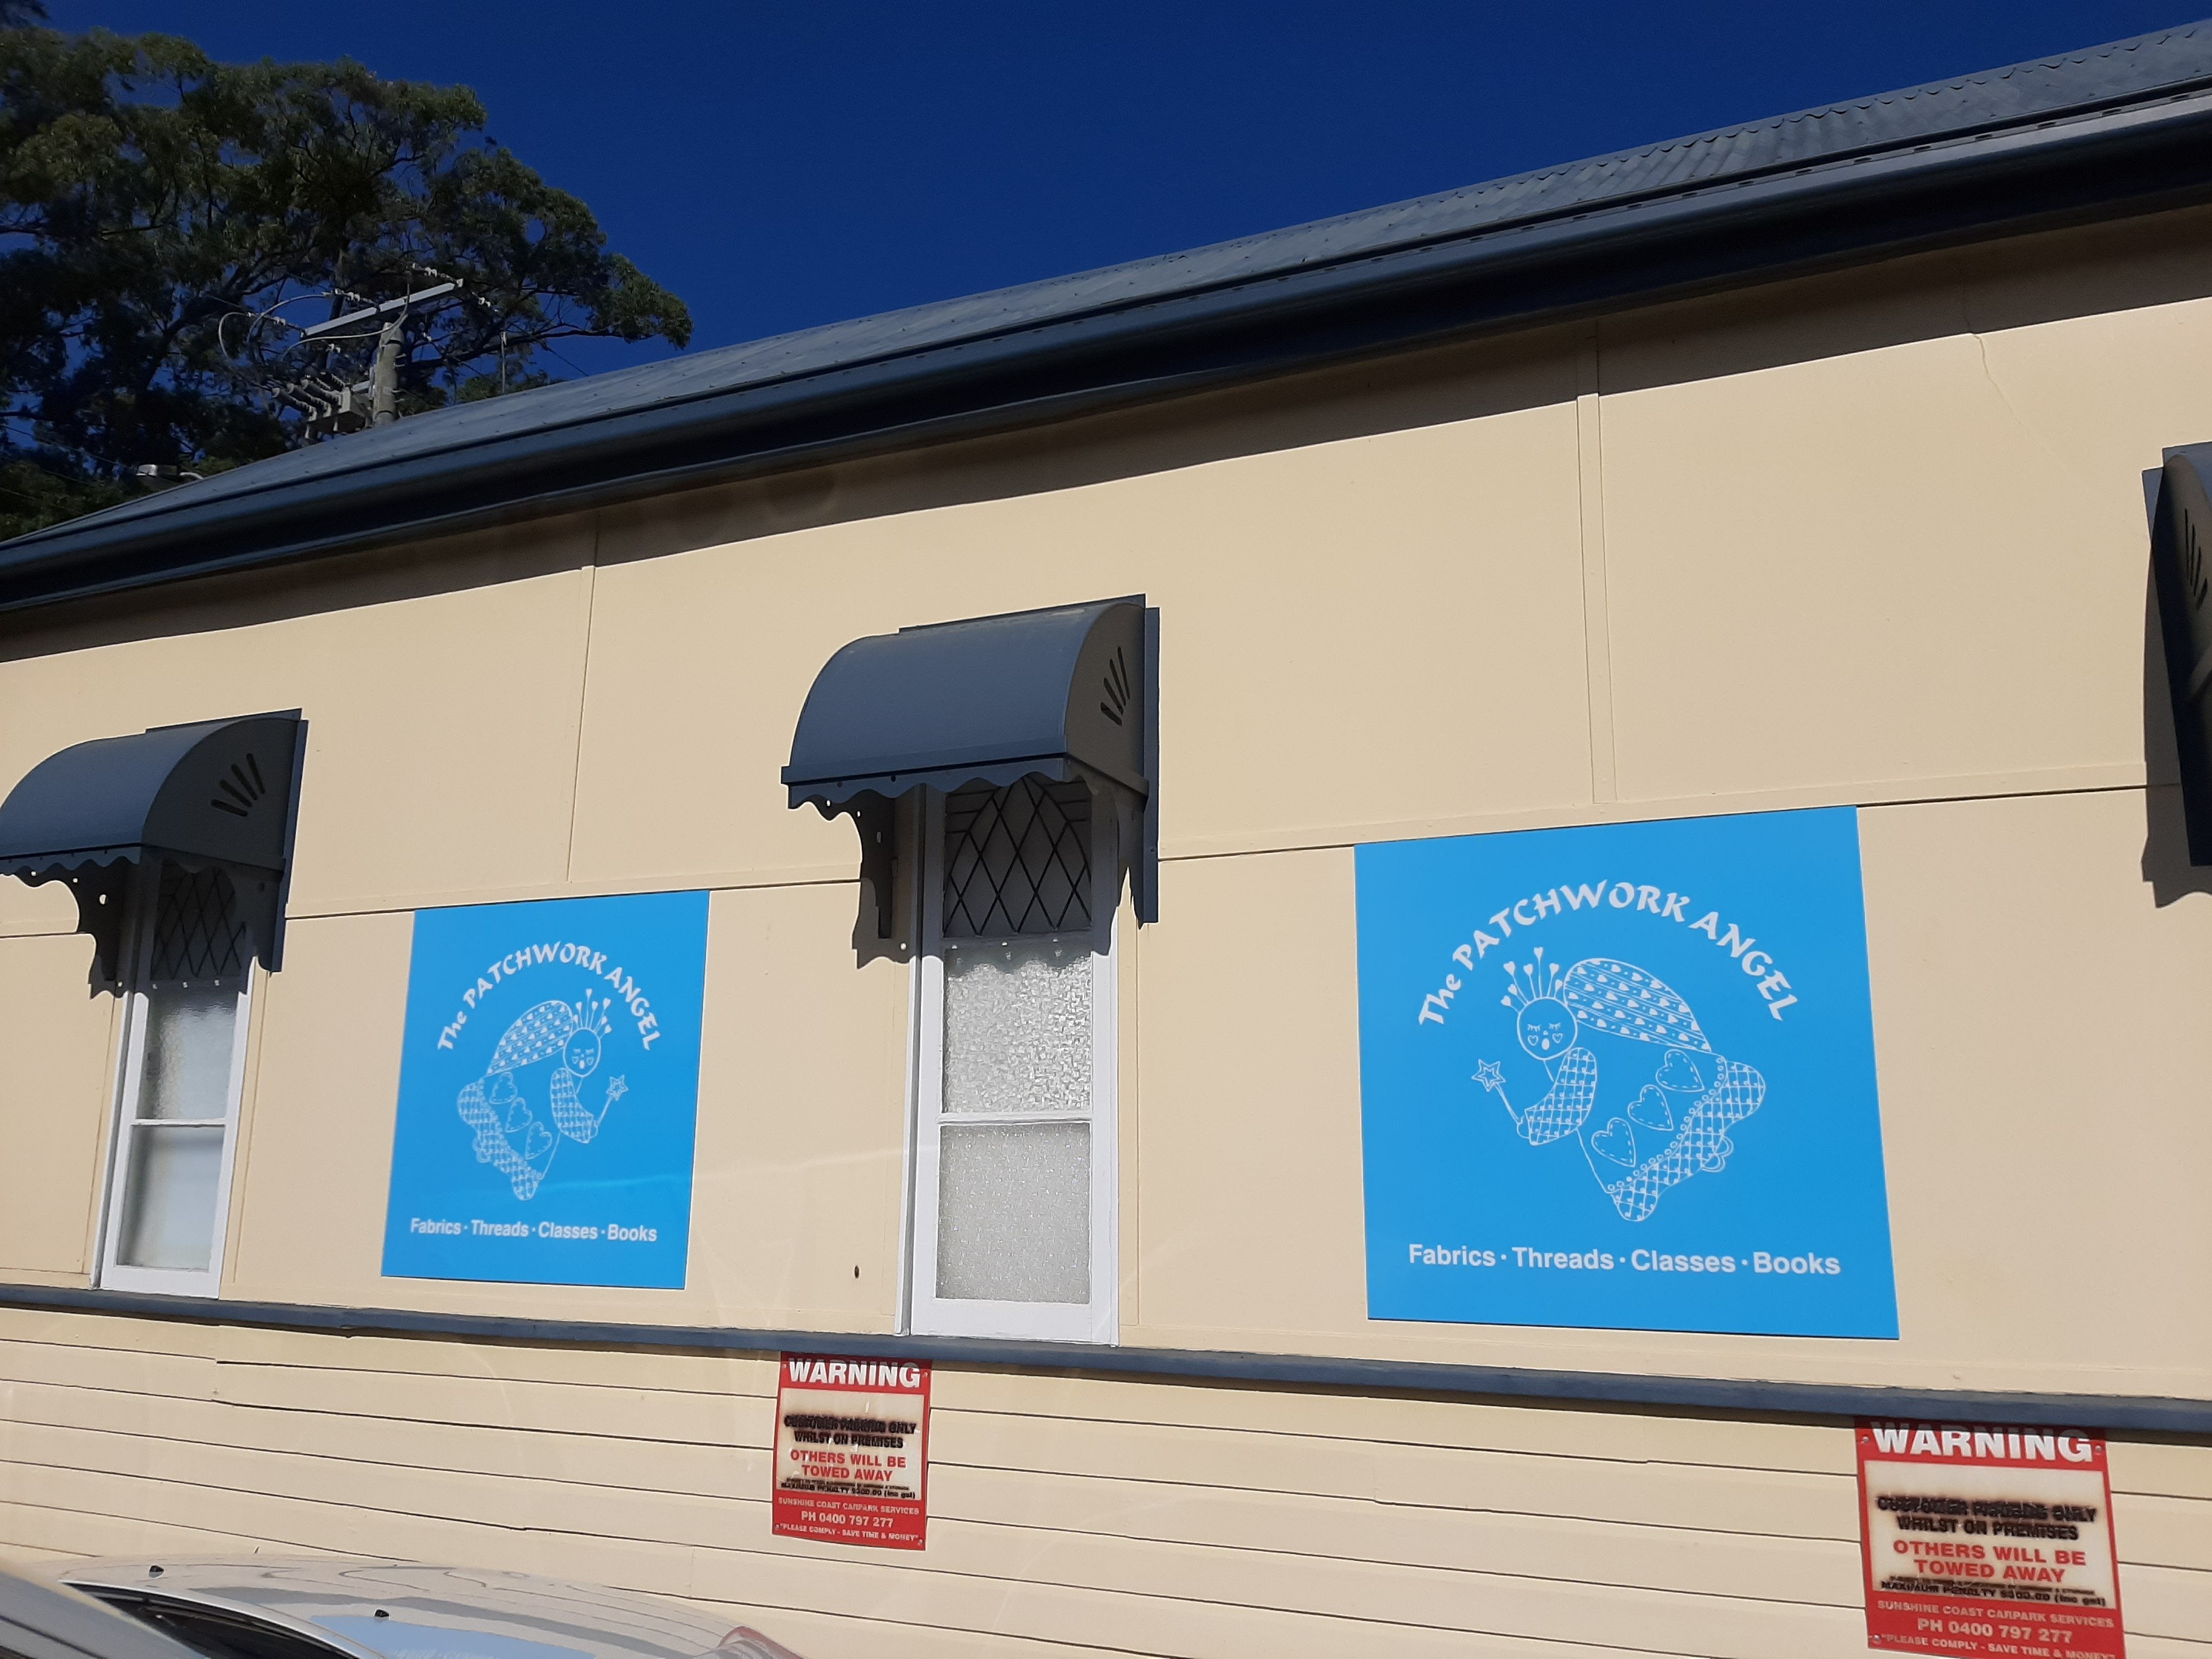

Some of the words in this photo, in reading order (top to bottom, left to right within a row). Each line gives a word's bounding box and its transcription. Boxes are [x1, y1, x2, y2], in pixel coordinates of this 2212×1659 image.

[1418, 973, 1462, 1025] The
[1453, 879, 1691, 972] PATCHWORK
[1689, 911, 1798, 1021] ANGEL
[437, 1010, 467, 1051] The
[463, 940, 608, 1008] PATCHWORK
[605, 967, 662, 1051] ANGEL
[410, 1218, 461, 1235] Fabrics
[471, 1220, 529, 1238] Threads
[538, 1222, 598, 1240] Classes
[608, 1224, 658, 1242] Books
[1408, 1244, 1496, 1267] Fabrics
[1511, 1247, 1615, 1271] Threads
[1630, 1250, 1736, 1273] Classes
[1752, 1251, 1841, 1275] Books
[789, 1358, 921, 1387] WARNING
[833, 1432, 848, 1444] ON
[1870, 1421, 2093, 1463] WARNING
[790, 1449, 845, 1464] OTHERS
[850, 1454, 882, 1466] WILL
[887, 1456, 906, 1468] BE
[802, 1464, 850, 1479] TOWED
[854, 1469, 893, 1481] AWAY
[778, 1497, 815, 1506] SUNSHINE
[816, 1501, 841, 1509] COAST
[881, 1505, 919, 1515] SERVICES
[801, 1510, 816, 1522] PH
[819, 1513, 846, 1525] 0400
[849, 1515, 869, 1526] 797
[873, 1516, 893, 1528] 277
[1897, 1515, 1959, 1533] WHILST
[1963, 1518, 1988, 1534] ON
[809, 1526, 836, 1534] COMPLY
[842, 1529, 860, 1537] SAVE
[1893, 1539, 1985, 1559] OTHERS
[1993, 1546, 2047, 1564] WILL
[2055, 1550, 2086, 1566] BE
[1914, 1559, 1995, 1578] TOWED
[2003, 1566, 2066, 1583] AWAY
[1877, 1600, 1939, 1613] SUNSHINE
[1943, 1605, 1984, 1617] COAST
[1987, 1608, 2046, 1622] CARPARK
[2050, 1613, 2114, 1627] SERVICES
[1917, 1617, 1943, 1633] PH
[1949, 1621, 1994, 1637] 0400
[1998, 1624, 2032, 1640] 797
[2038, 1628, 2073, 1644] 277
[1932, 1638, 1979, 1650] COMPLY
[1988, 1643, 2018, 1654] SAVE
[2020, 1645, 2050, 1657] TIME
[2053, 1649, 2062, 1658] &
